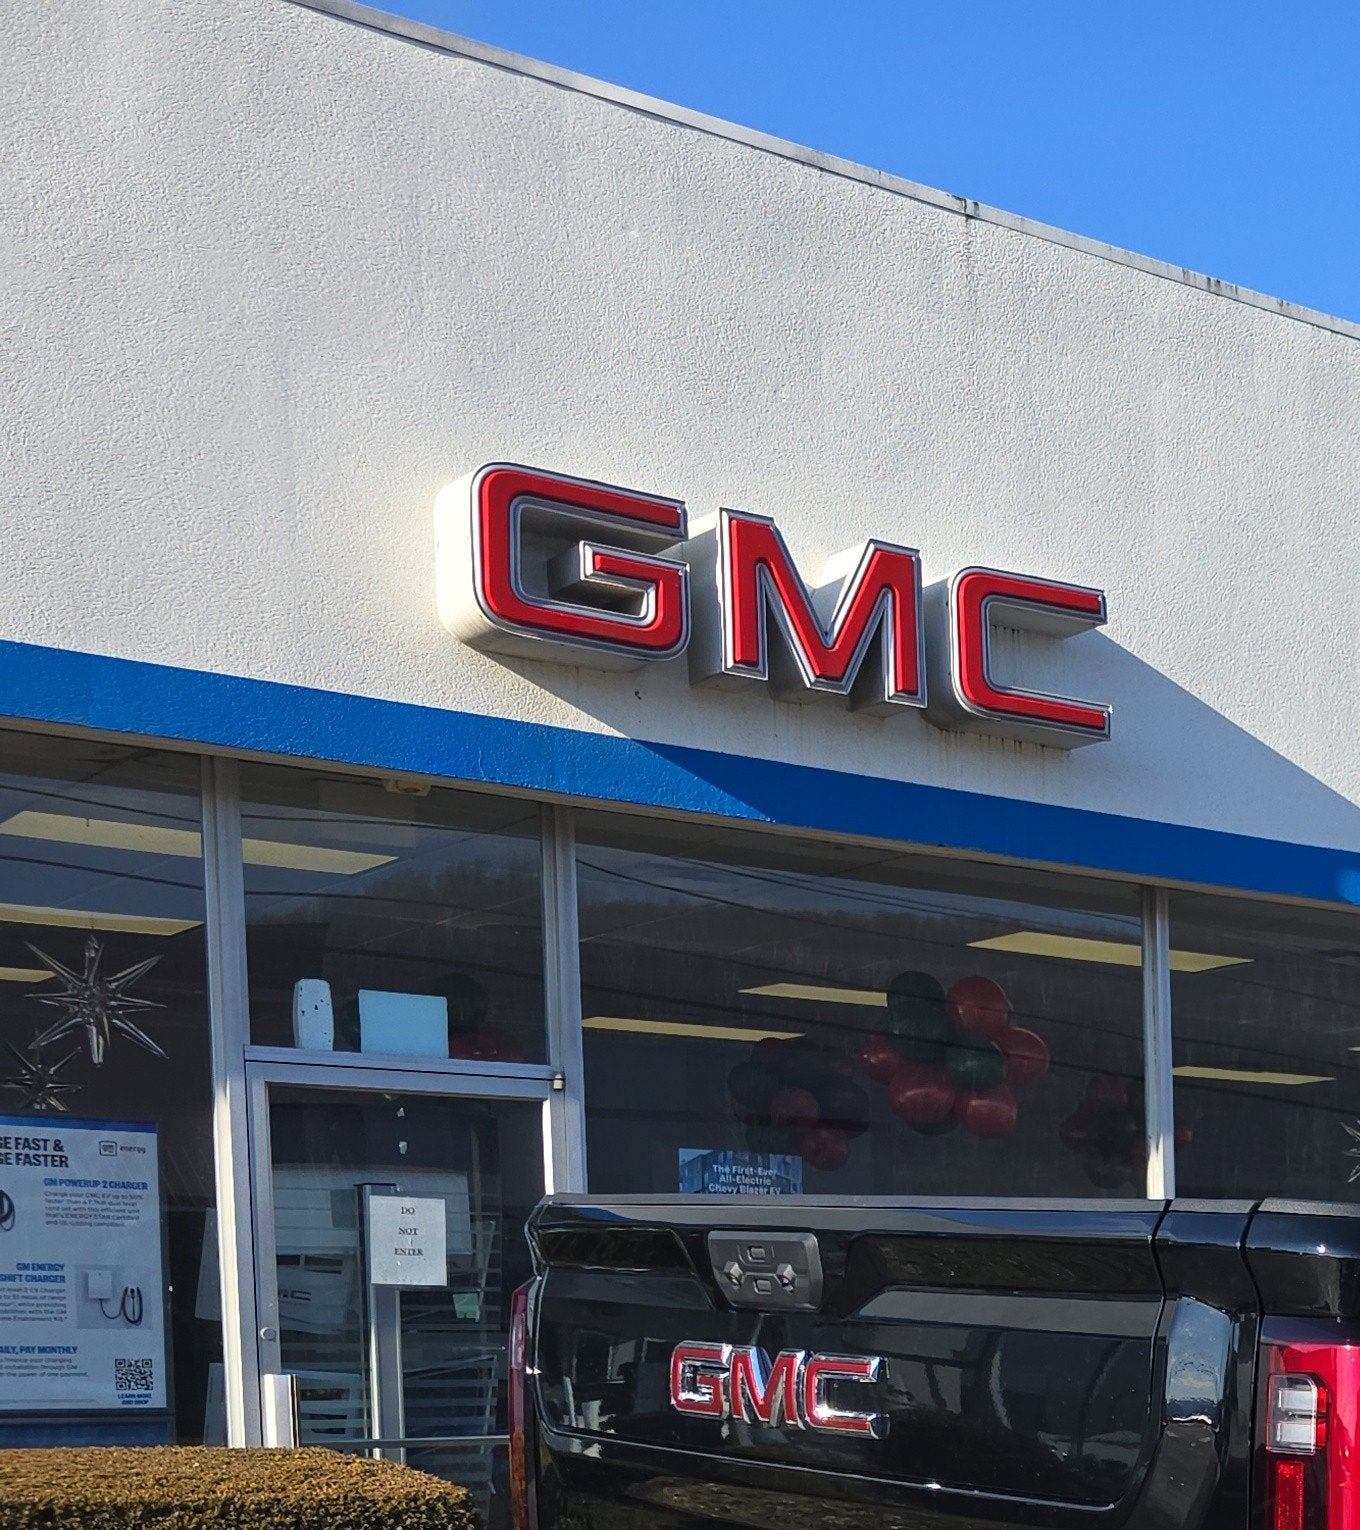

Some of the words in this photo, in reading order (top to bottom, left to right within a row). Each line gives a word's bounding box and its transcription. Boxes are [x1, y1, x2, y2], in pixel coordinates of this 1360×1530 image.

[440, 461, 1113, 746] GMC
[14, 1137, 50, 1152] FAST
[53, 1139, 65, 1152] &
[120, 1146, 146, 1154] energy
[15, 1152, 69, 1168] FASTER
[712, 1164, 730, 1173] The
[732, 1165, 778, 1176] First-Ever
[59, 1179, 101, 1188] POWERUP
[102, 1180, 108, 1189] 2
[109, 1181, 148, 1190] CHARGER
[719, 1174, 772, 1186] All-Electric
[708, 1183, 738, 1195] Chevy
[740, 1185, 768, 1195] Blazer
[770, 1186, 781, 1195] EV
[401, 1206, 416, 1215] DO
[398, 1227, 419, 1236] NOT
[394, 1248, 424, 1257] ENTER
[16, 1263, 30, 1272] GM
[32, 1263, 65, 1272] ENERGY
[25, 1274, 66, 1284] CHARGER
[20, 1346, 37, 1354] PAY
[38, 1346, 78, 1354] MONTHLY
[669, 1340, 891, 1440] GMC
